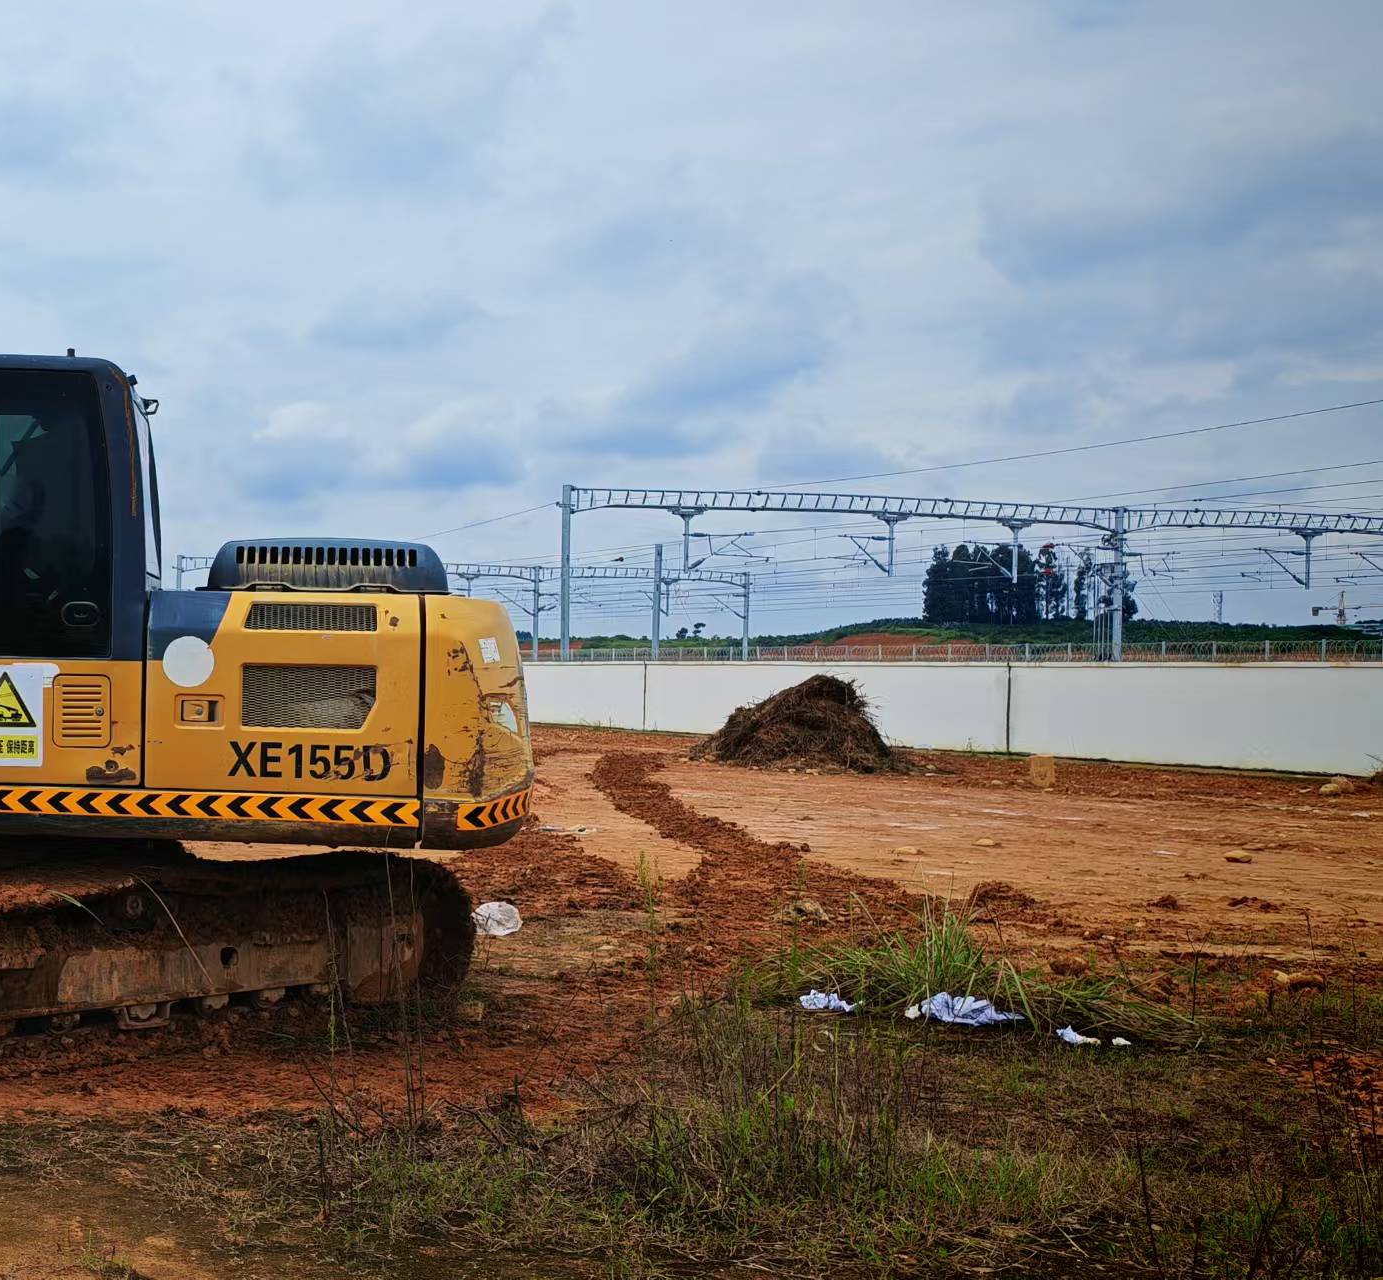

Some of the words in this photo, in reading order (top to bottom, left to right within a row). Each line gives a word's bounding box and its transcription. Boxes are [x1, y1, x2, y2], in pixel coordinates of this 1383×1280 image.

[6, 739, 35, 755] 保持距离
[228, 741, 391, 781] XE155D
